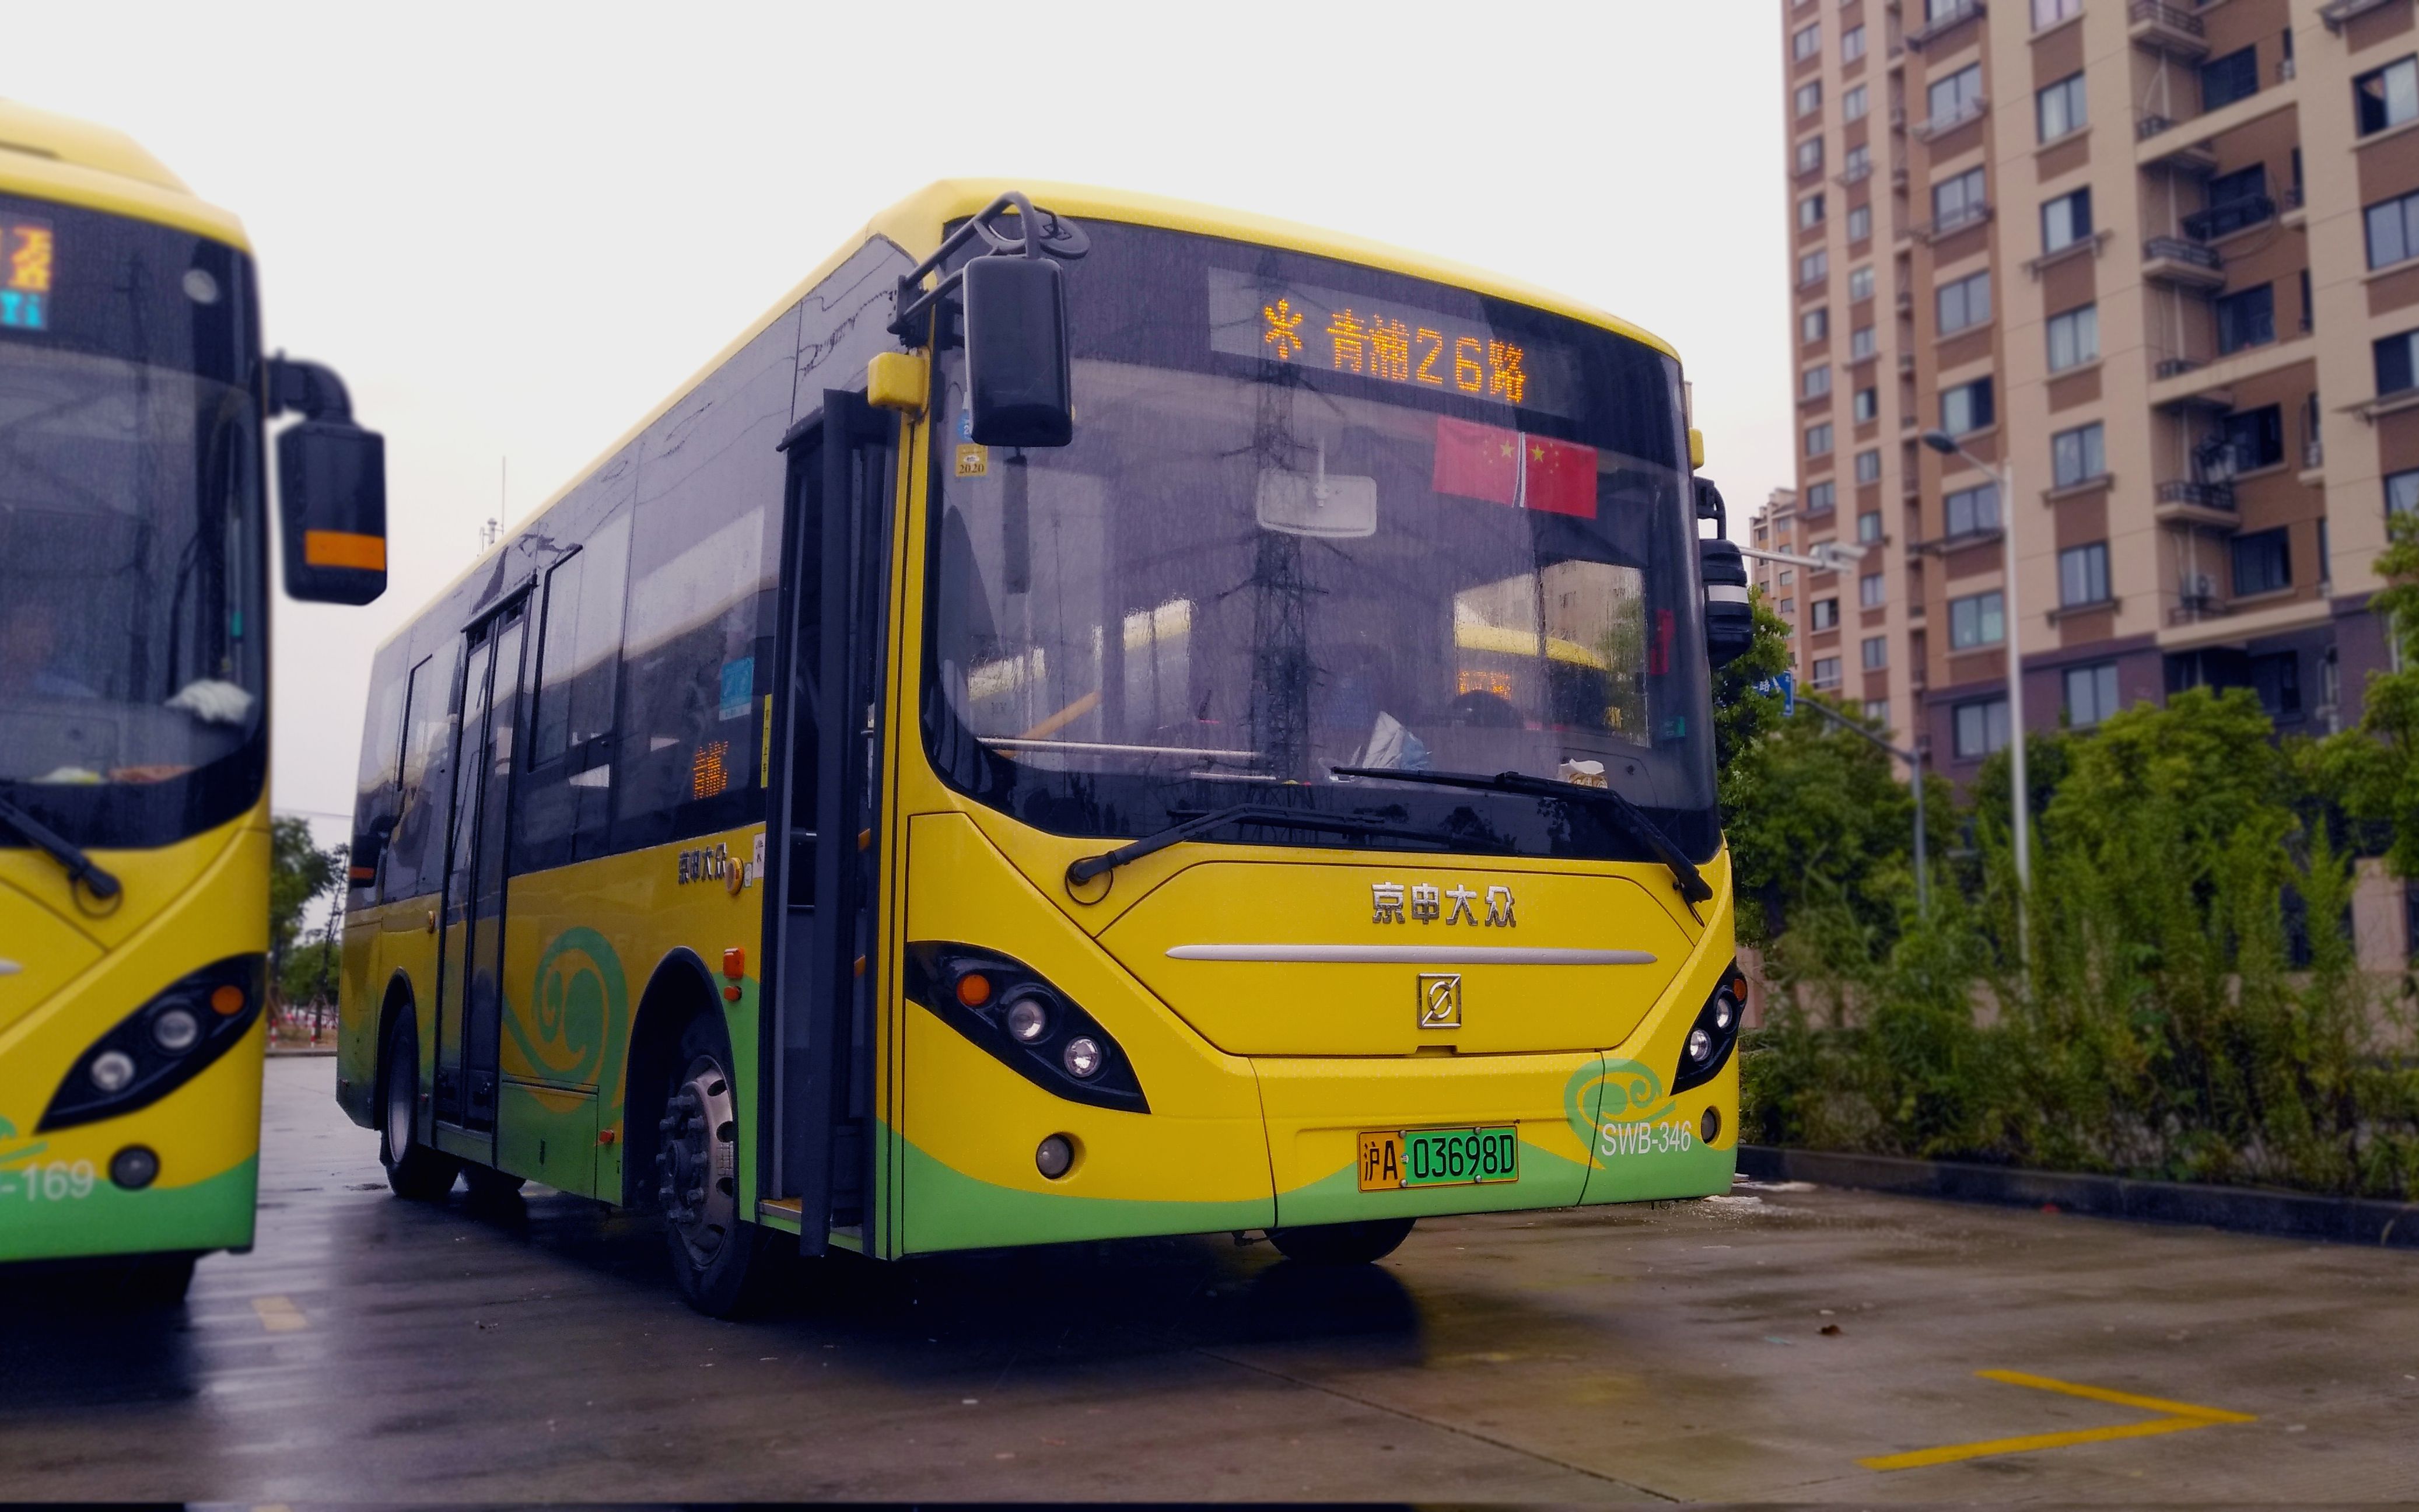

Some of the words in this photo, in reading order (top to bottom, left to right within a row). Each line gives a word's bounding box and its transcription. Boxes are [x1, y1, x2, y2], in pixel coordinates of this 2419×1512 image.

[1326, 308, 1527, 402] 青浦26路
[959, 464, 985, 474] 2020
[678, 842, 728, 885] 京申大众
[1372, 881, 1517, 928] 京申大众
[1601, 1120, 1692, 1156] SWB-346
